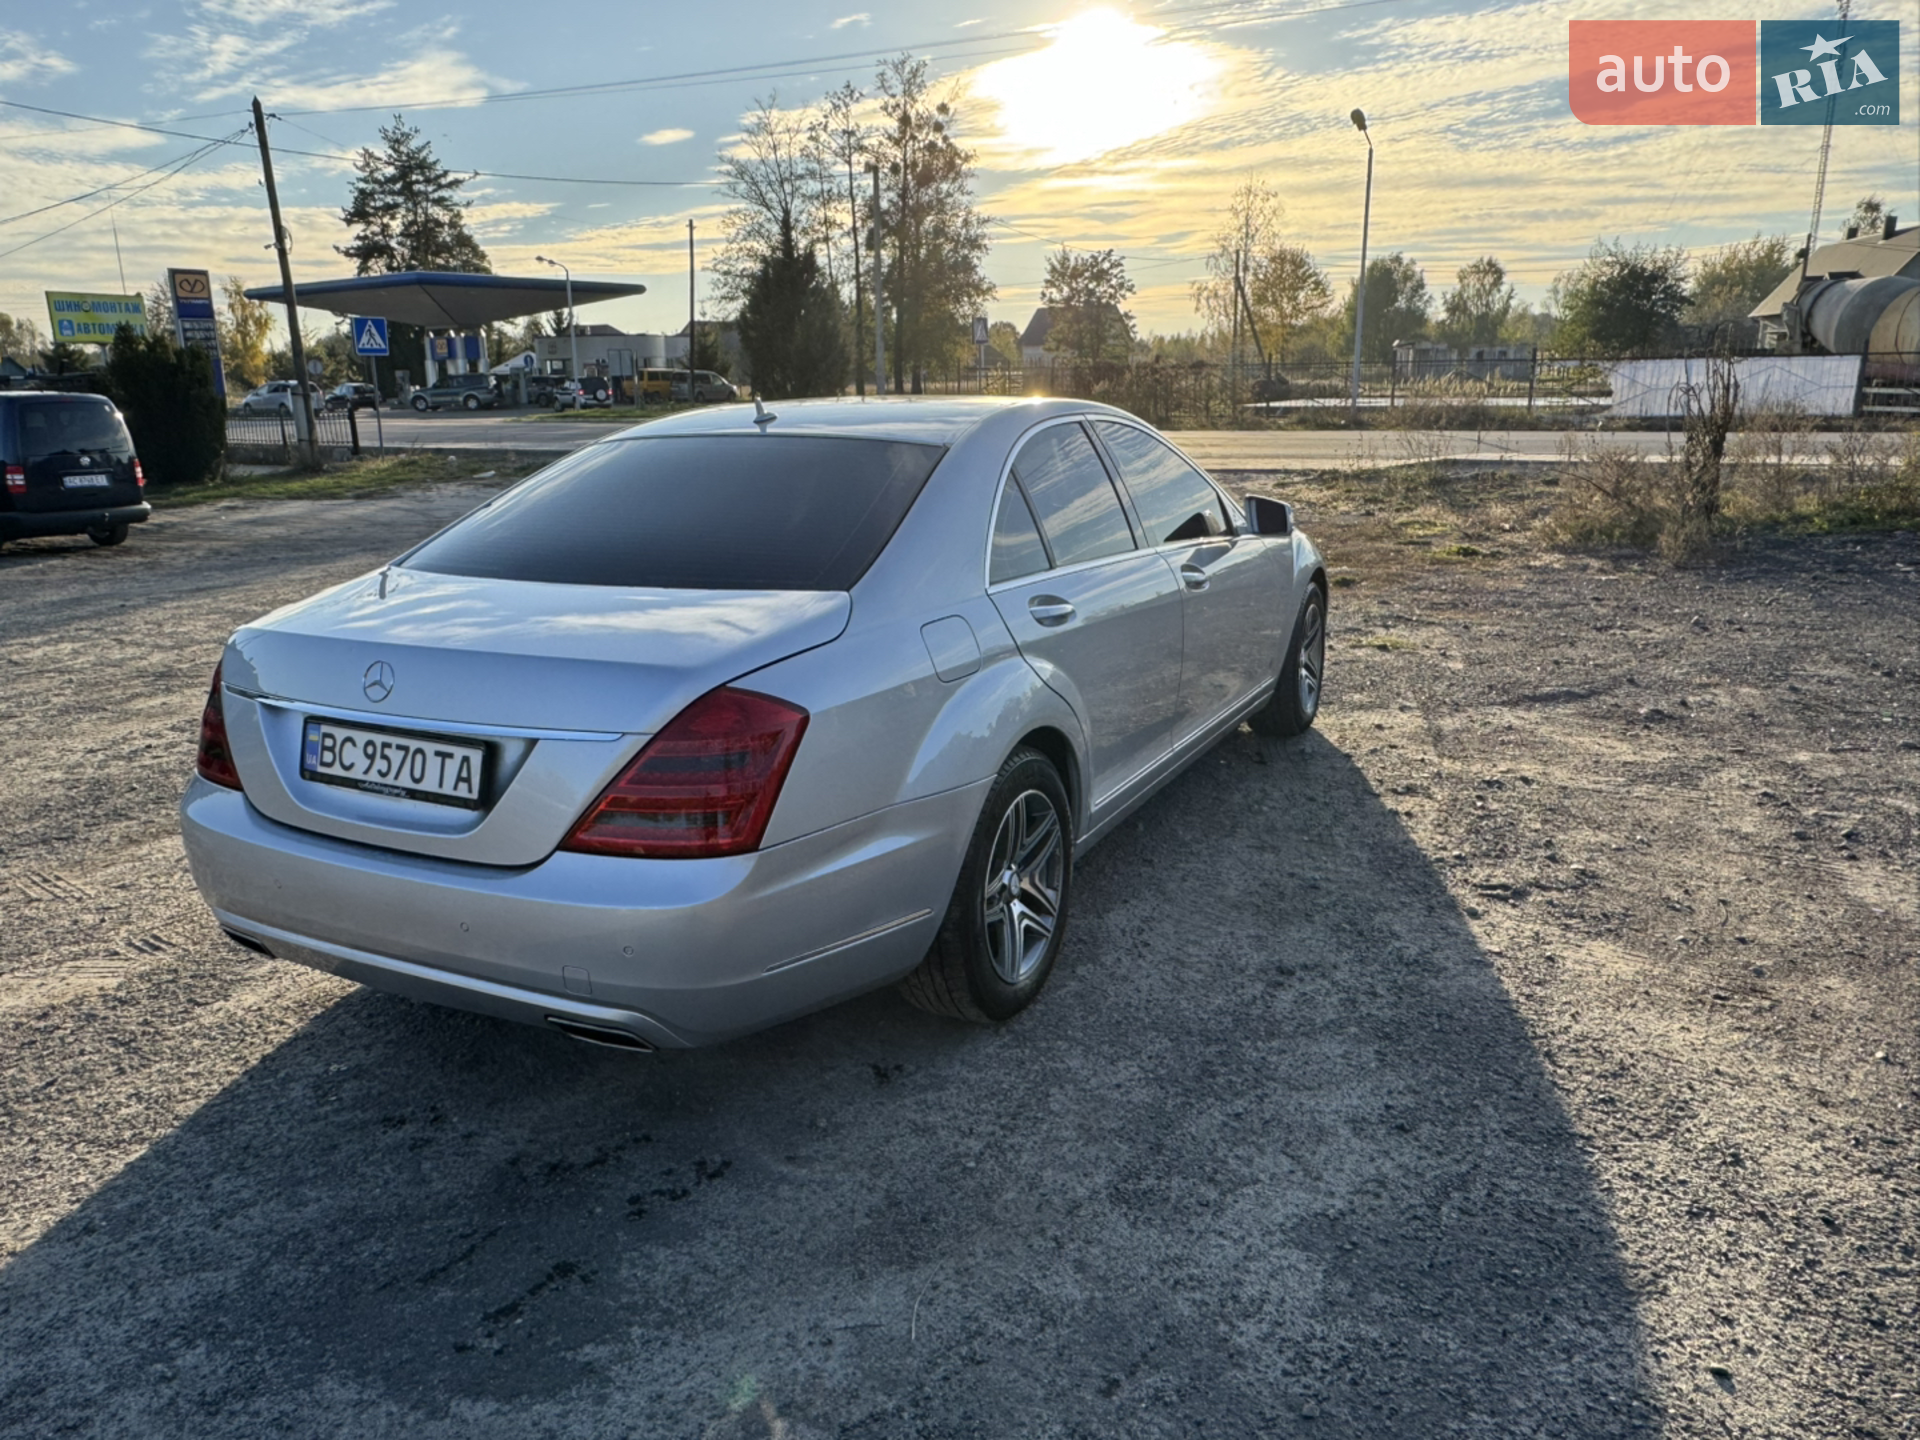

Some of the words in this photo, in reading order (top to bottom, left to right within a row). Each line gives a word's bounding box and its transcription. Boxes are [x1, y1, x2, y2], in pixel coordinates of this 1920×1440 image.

[76, 322, 145, 336] АВТОМКА
[306, 753, 317, 765] UA
[319, 732, 357, 771] BC
[362, 739, 427, 785] 9570
[434, 750, 473, 794] TA
